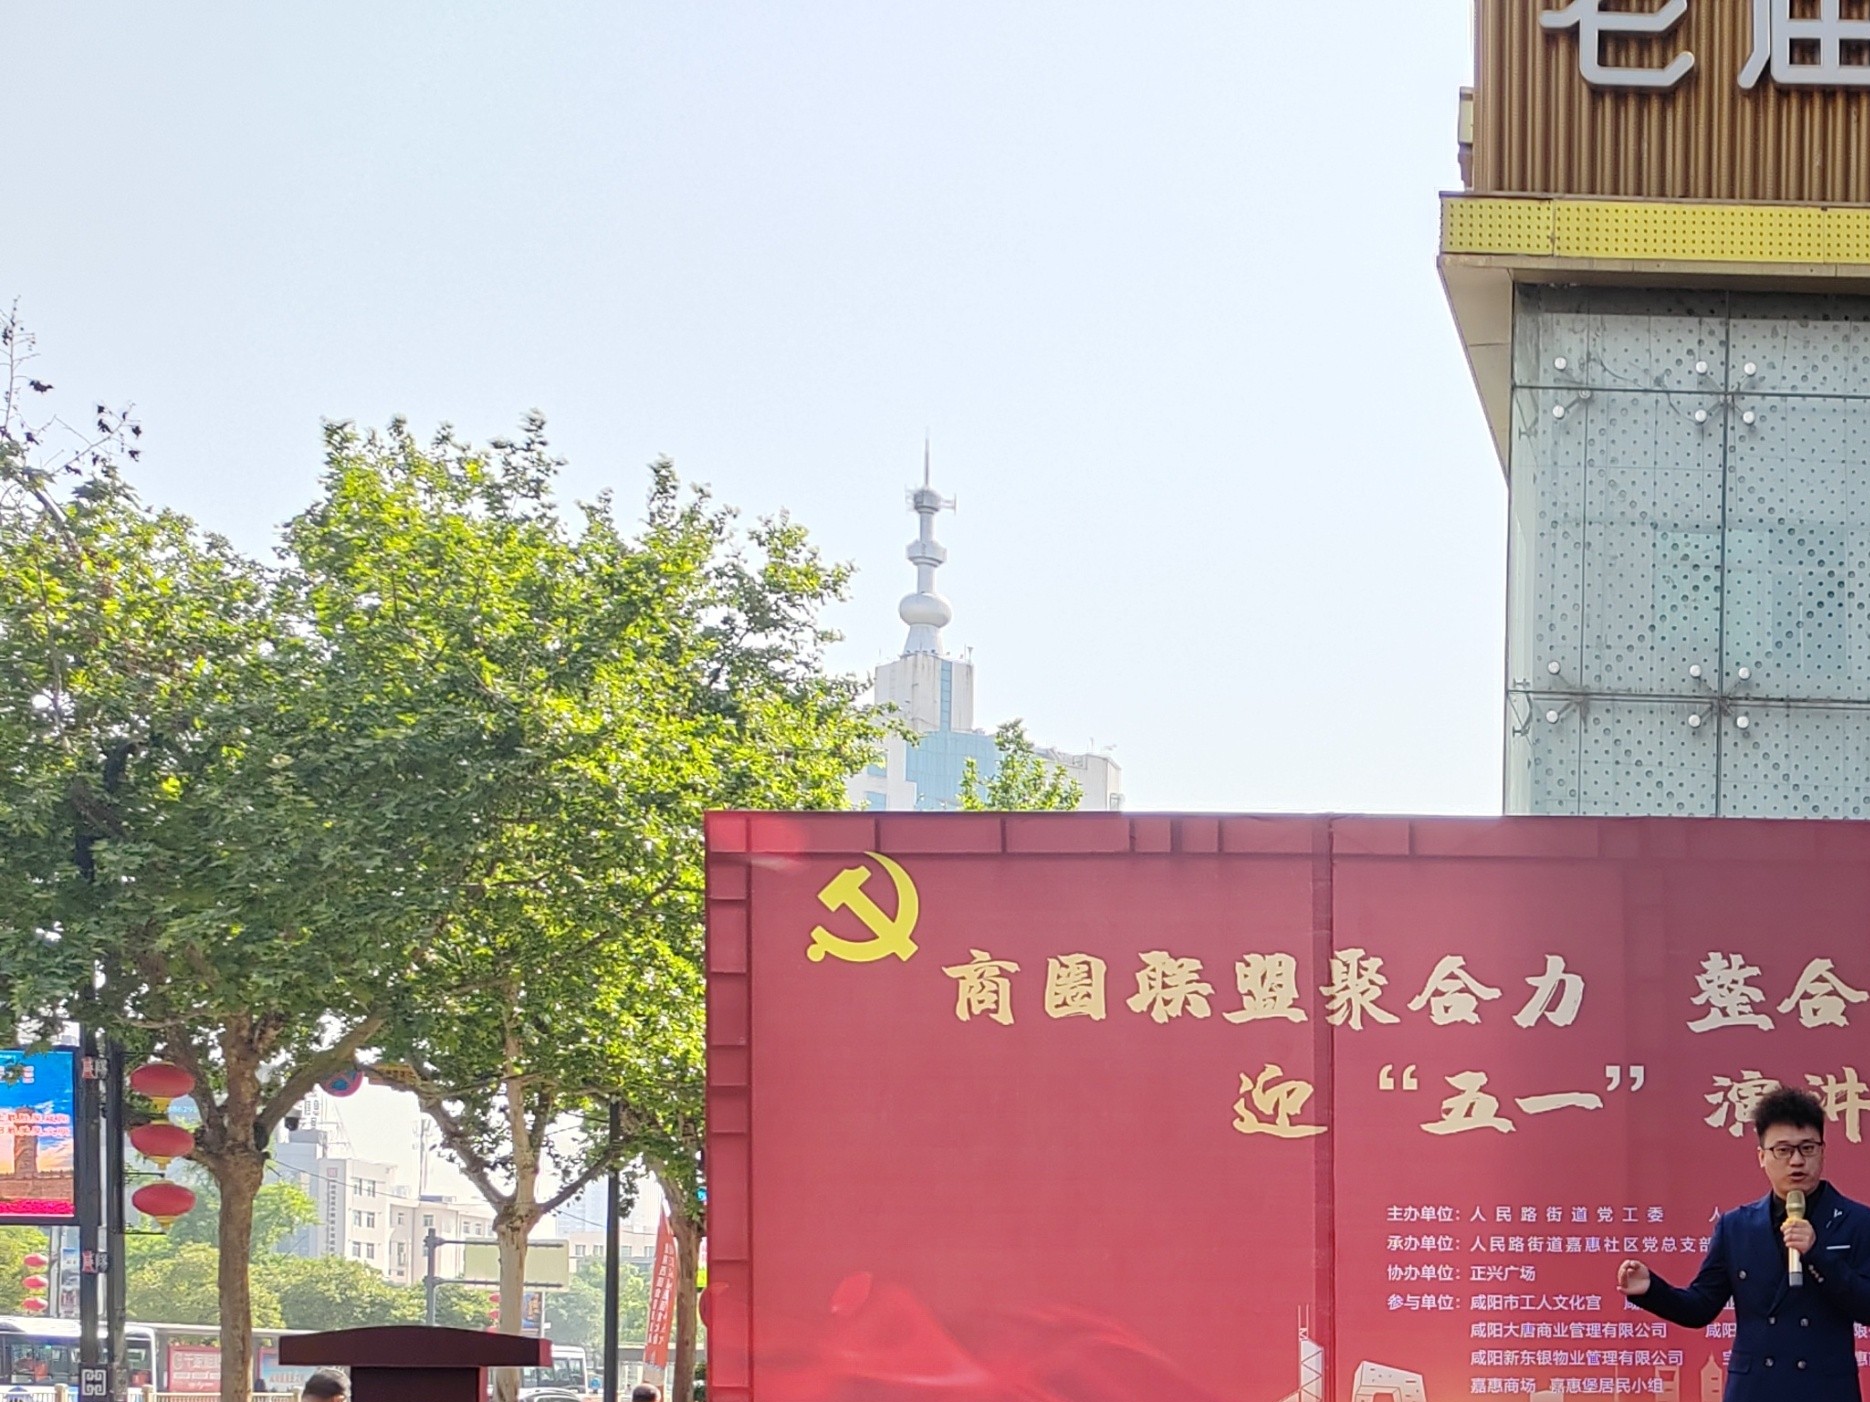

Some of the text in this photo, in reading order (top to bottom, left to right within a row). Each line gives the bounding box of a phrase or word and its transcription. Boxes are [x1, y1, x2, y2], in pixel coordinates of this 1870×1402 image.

[942, 947, 1587, 1031] 商圈联盟聚合力
[1470, 1322, 1668, 1338] 咸阳大唐商业管理有限公司
[1470, 1350, 1683, 1367] 咸阳新东银物业管理有限公司
[1470, 1378, 1664, 1394] 嘉惠商场 嘉惠堡居民小组
